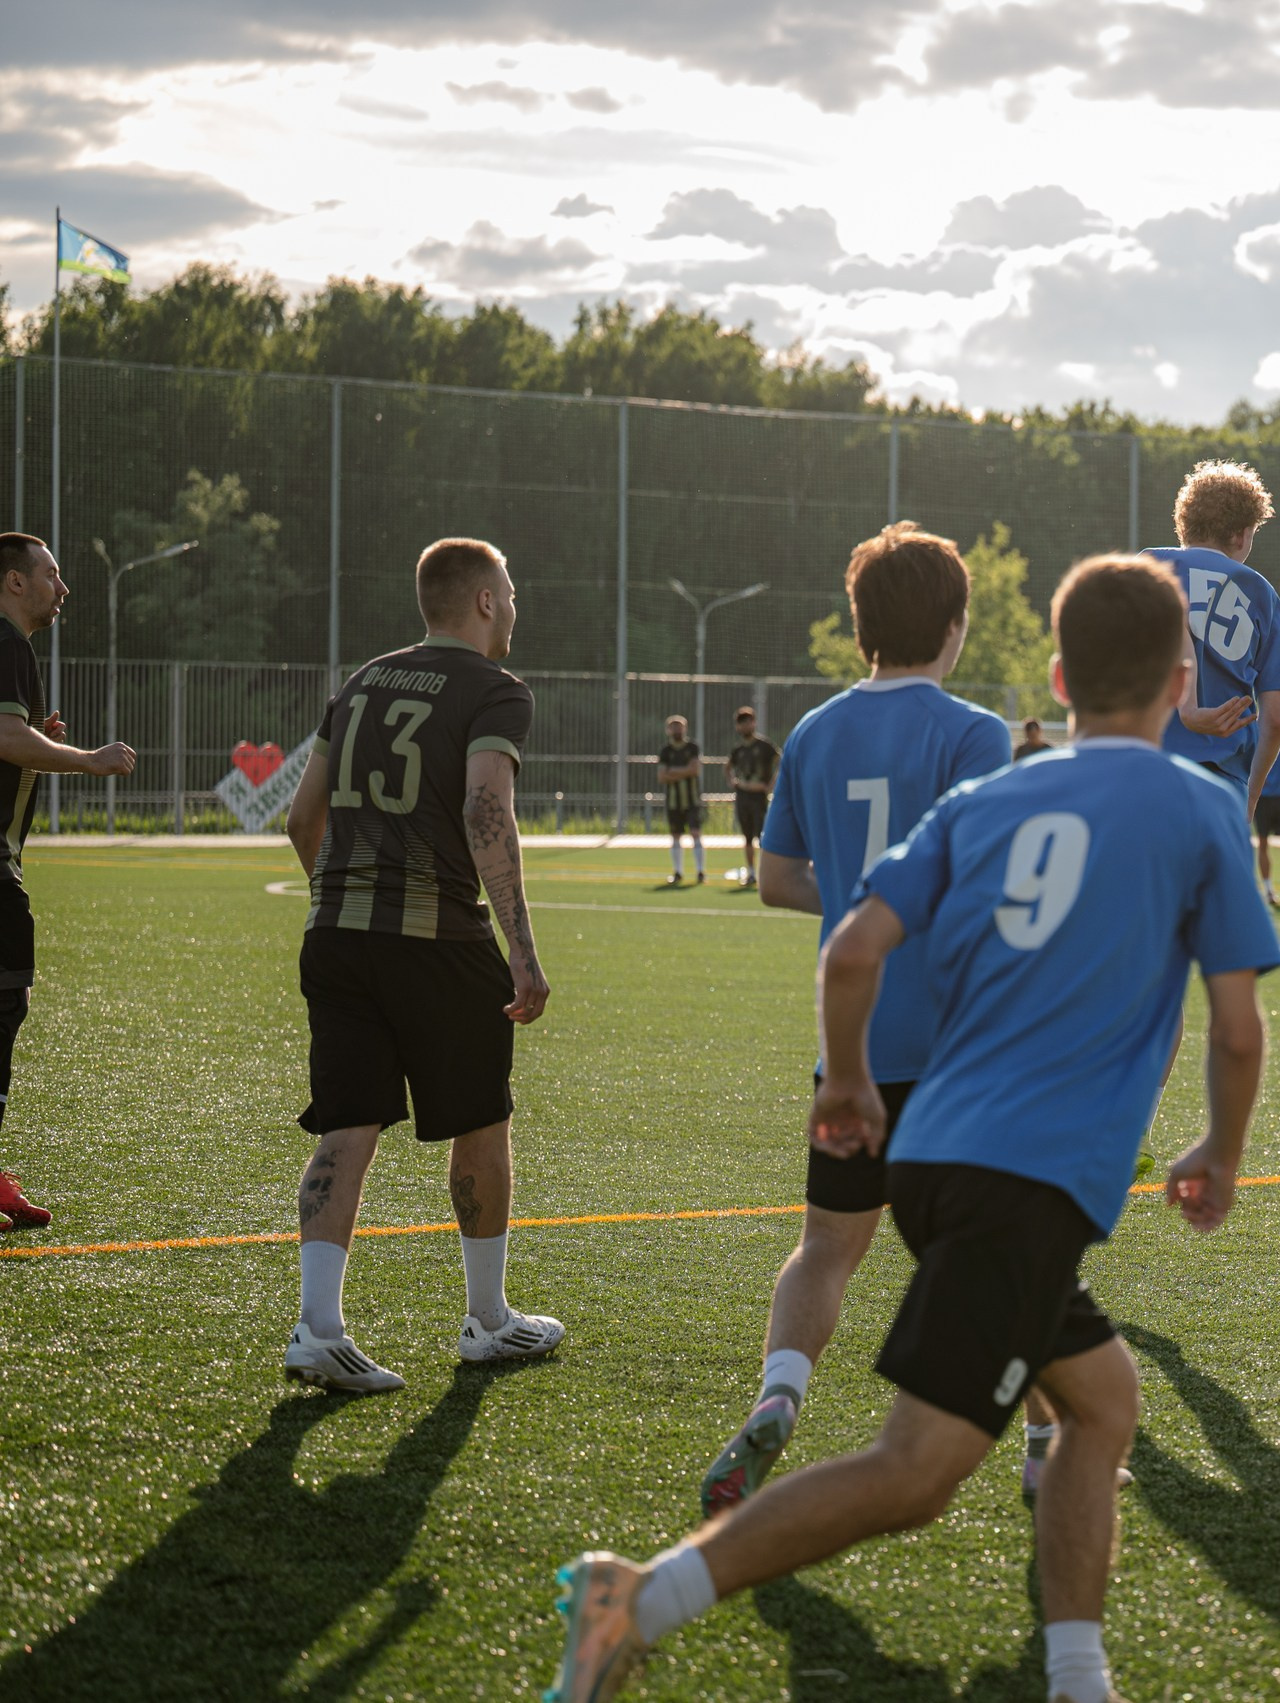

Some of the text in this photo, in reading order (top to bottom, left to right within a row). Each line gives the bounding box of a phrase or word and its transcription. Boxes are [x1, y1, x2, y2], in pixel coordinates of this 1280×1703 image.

[1188, 567, 1255, 662] 55
[361, 665, 448, 695] ФИЛИПОВ
[330, 693, 433, 814] 13
[847, 777, 890, 878] 7
[994, 812, 1091, 951] 9
[994, 1357, 1028, 1406] 9
